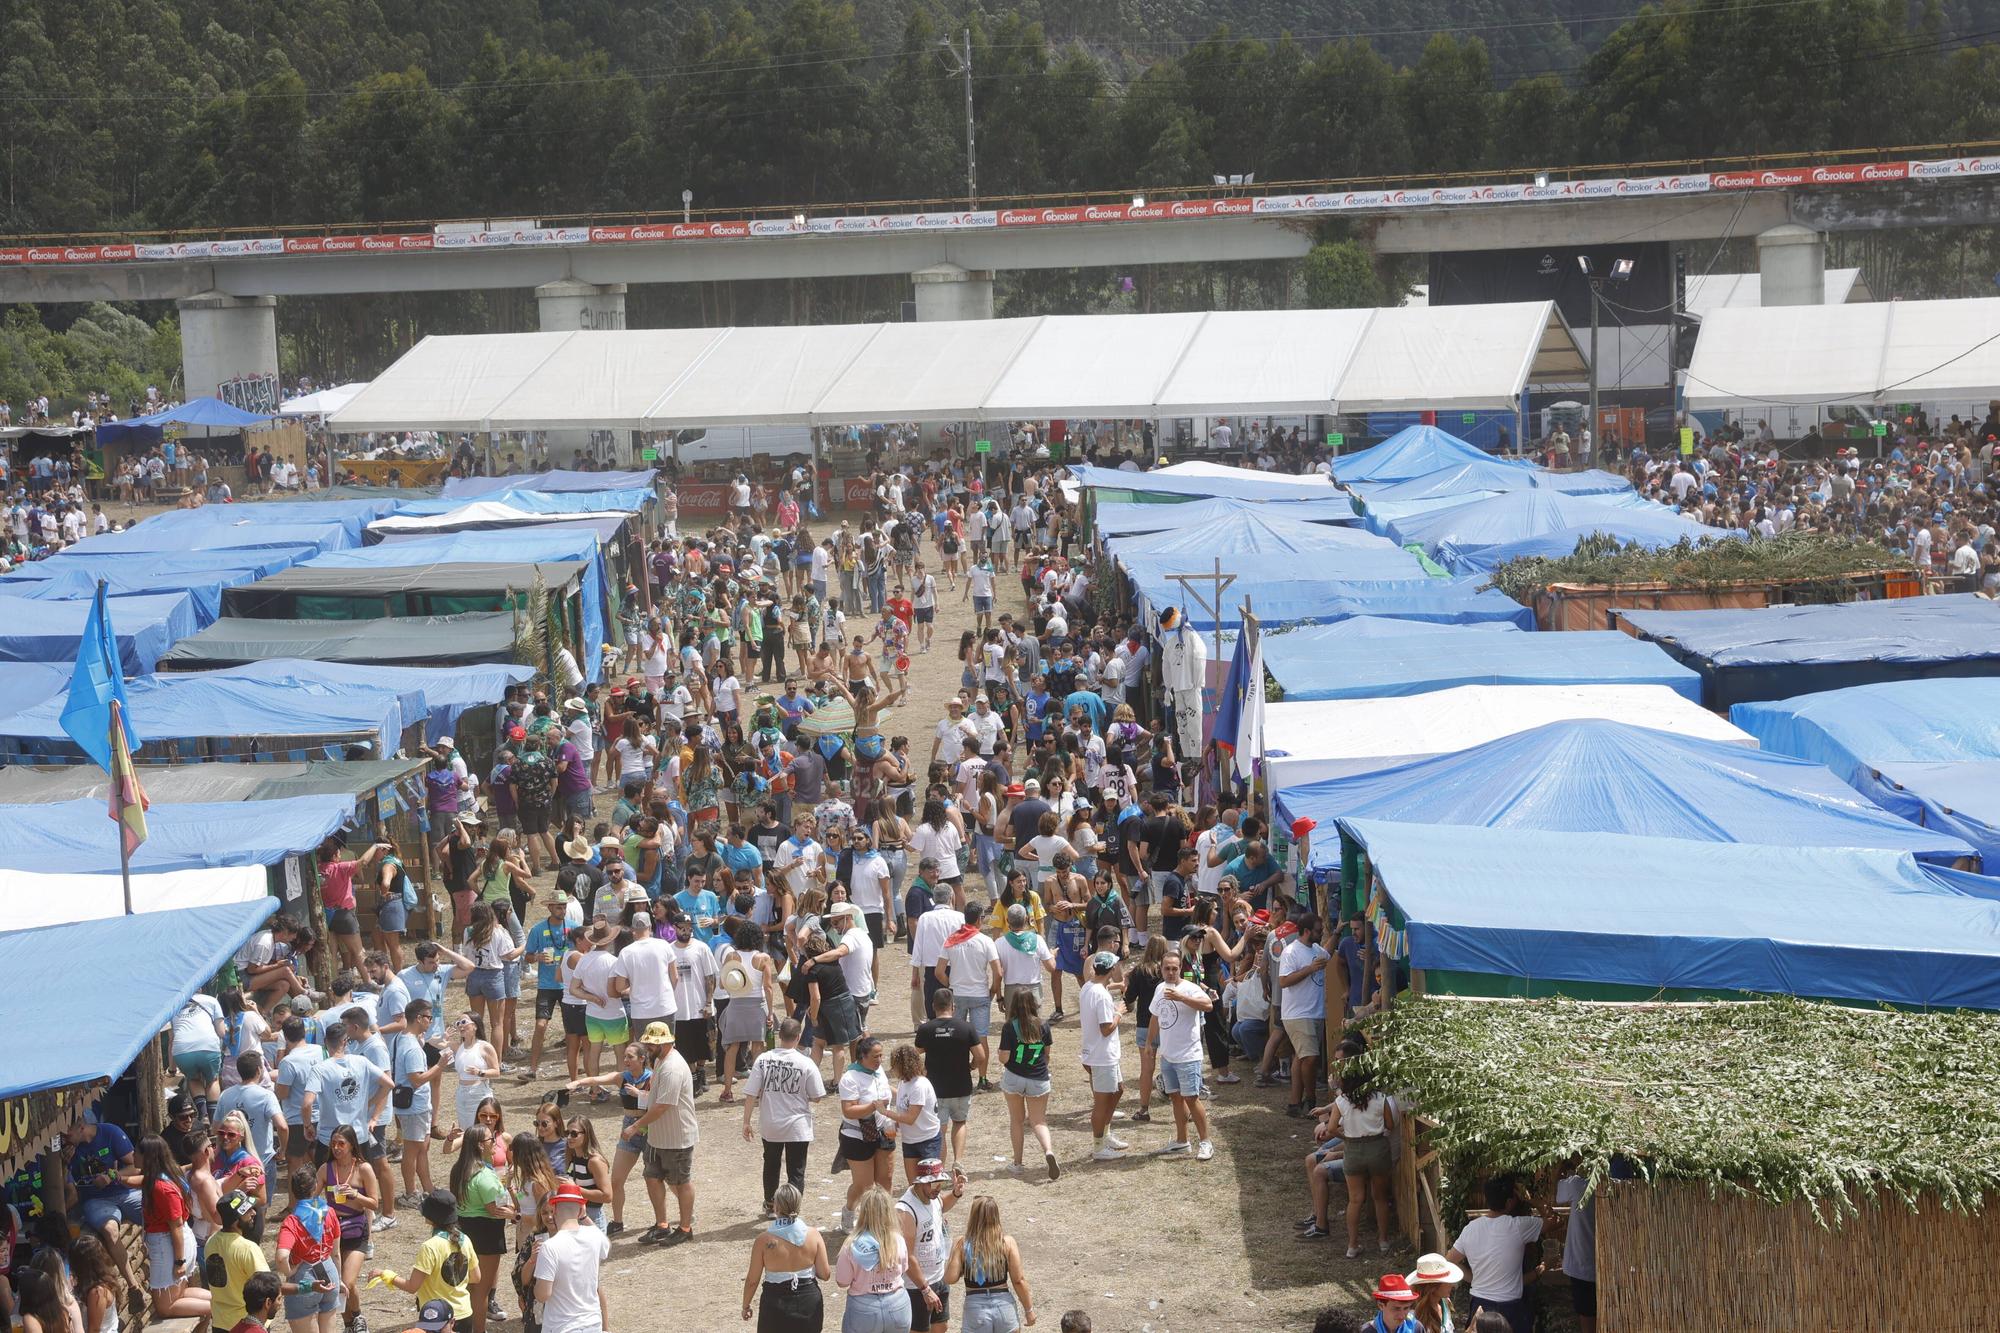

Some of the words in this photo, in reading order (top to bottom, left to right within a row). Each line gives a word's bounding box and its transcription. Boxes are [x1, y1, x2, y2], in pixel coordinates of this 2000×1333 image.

[1714, 175, 1755, 187] ebroker
[1761, 172, 1802, 184] ebroker
[1812, 168, 1854, 181] ebroker
[1861, 166, 1904, 179] ebroker
[1913, 164, 1951, 175] ebroker
[1256, 200, 1289, 209] ebroker
[1305, 196, 1340, 208] ebroker
[1344, 194, 1378, 205] ebroker
[1394, 191, 1429, 203] ebroker
[1433, 190, 1466, 201] ebroker
[1482, 188, 1519, 199] ebroker
[1524, 186, 1558, 197] ebroker
[1575, 182, 1612, 193] ebroker
[1617, 181, 1652, 192] ebroker
[1669, 178, 1707, 190] ebroker
[1001, 212, 1036, 223] ebroker
[1042, 210, 1077, 221] ebroker
[1085, 207, 1121, 218] ebroker
[1128, 205, 1163, 217] ebroker
[1171, 203, 1207, 214] ebroker
[1213, 201, 1250, 212] ebroker
[754, 223, 784, 232] ebroker
[835, 219, 865, 229] ebroker
[880, 217, 912, 228] ebroker
[916, 216, 947, 226] ebroker
[963, 214, 995, 224] ebroker
[437, 235, 465, 245] ebroker
[479, 233, 510, 243] ebroker
[514, 232, 542, 242] ebroker
[556, 230, 587, 240] ebroker
[592, 228, 625, 239] ebroker
[631, 227, 664, 238] ebroker
[673, 225, 704, 236] ebroker
[710, 224, 744, 235] ebroker
[137, 247, 164, 256] ebroker
[177, 245, 207, 255] ebroker
[211, 243, 239, 253] ebroker
[252, 241, 281, 251] ebroker
[287, 240, 318, 250] ebroker
[323, 238, 355, 249] ebroker
[362, 238, 394, 249] ebroker
[400, 237, 431, 247] ebroker
[0, 253, 23, 261] broker
[28, 249, 58, 260] ebroker
[65, 249, 96, 260] ebroker
[100, 247, 131, 258] ebroker
[1015, 1044, 1044, 1065] 17
[920, 1229, 934, 1243] 19
